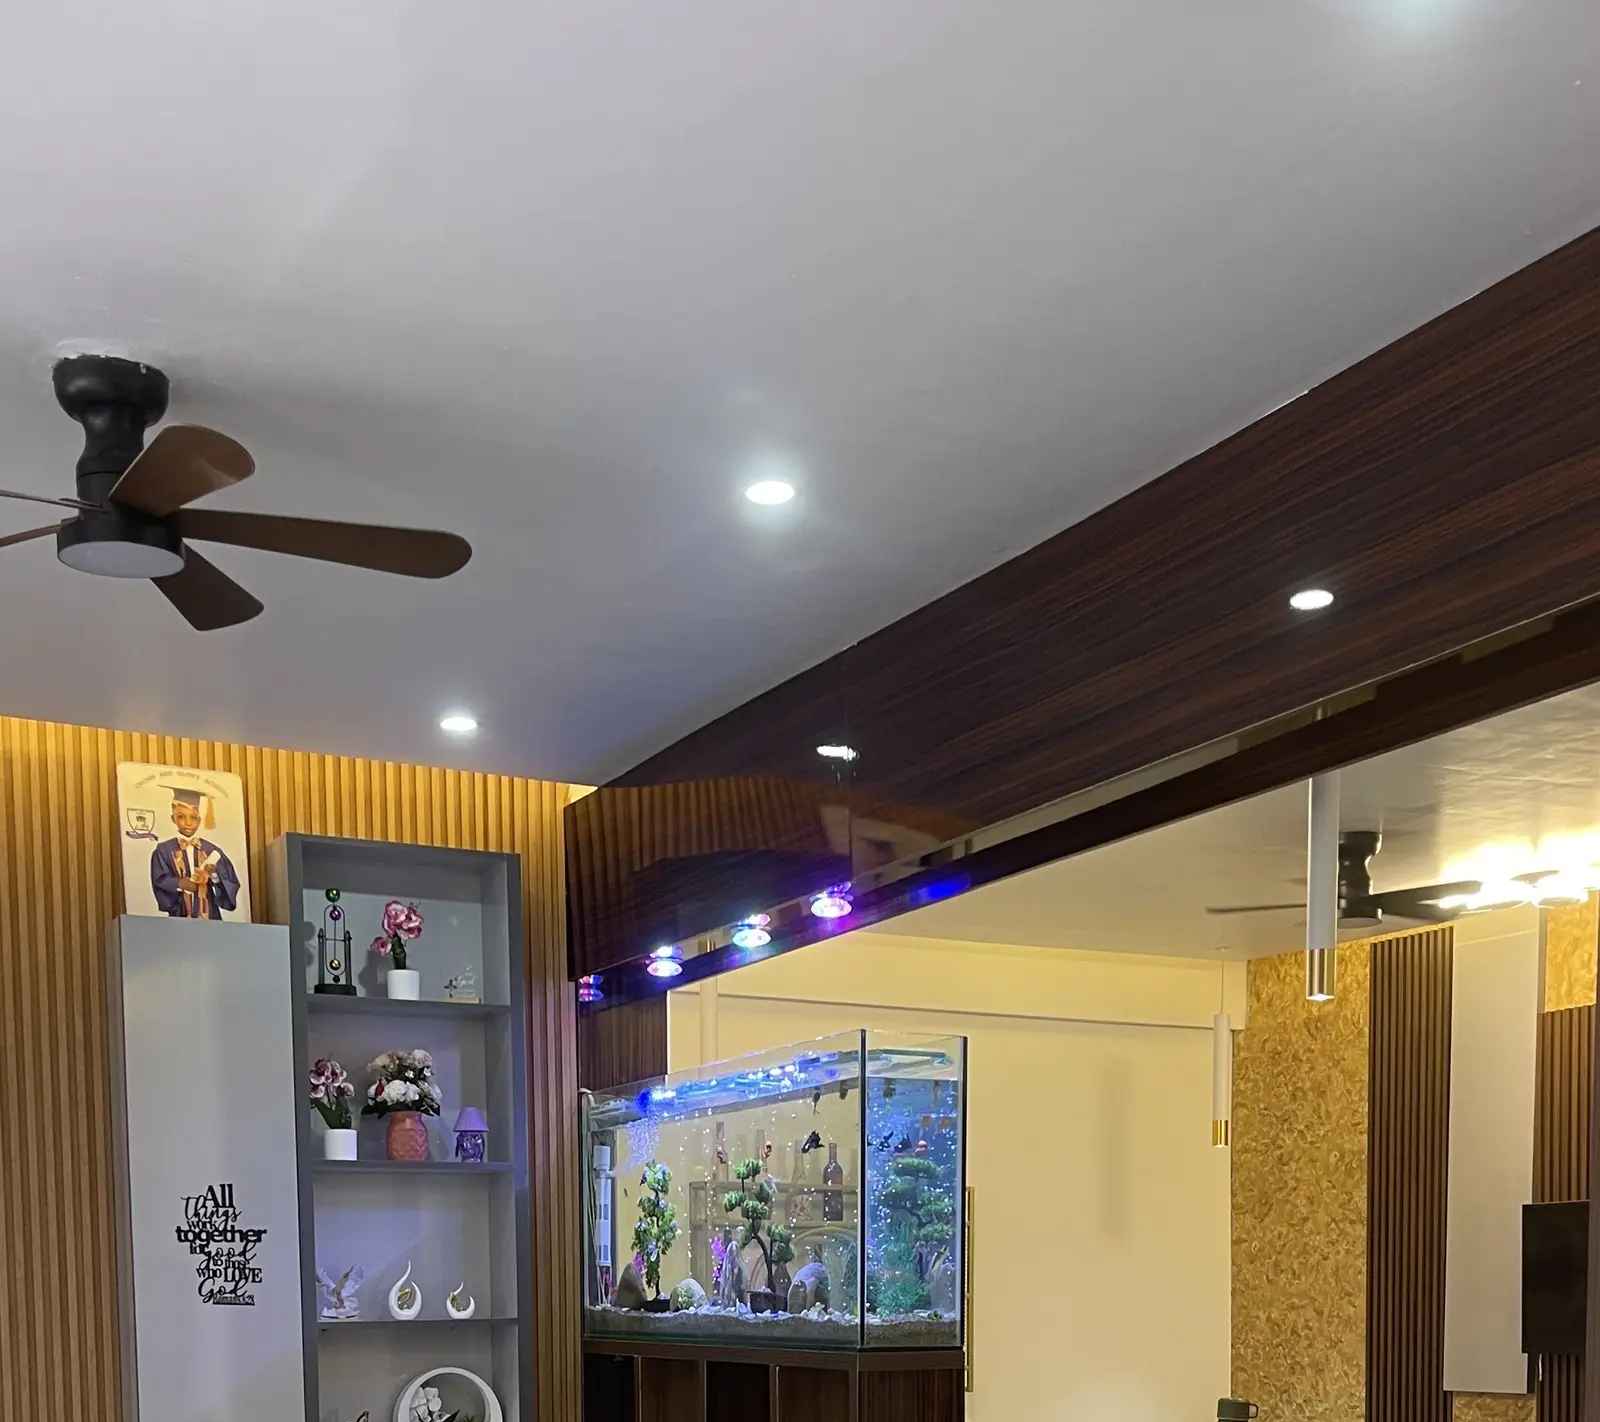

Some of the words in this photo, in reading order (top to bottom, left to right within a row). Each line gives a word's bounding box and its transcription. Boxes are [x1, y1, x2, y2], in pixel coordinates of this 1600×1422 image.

[205, 1183, 234, 1208] All
[175, 1225, 267, 1246] together
[187, 1220, 218, 1230] work
[199, 1241, 257, 1273] good
[196, 1267, 223, 1279] who
[223, 1267, 262, 1283] LOVE
[198, 1277, 248, 1304] God
